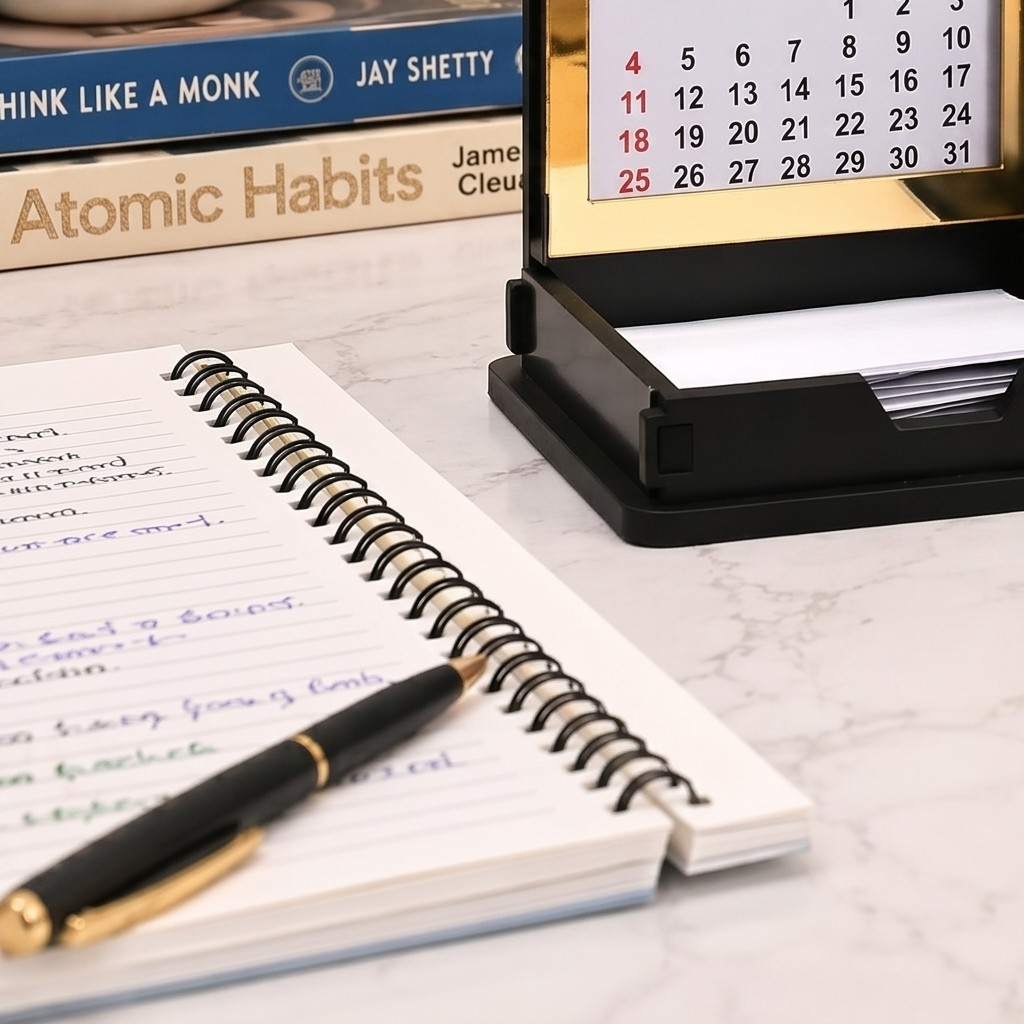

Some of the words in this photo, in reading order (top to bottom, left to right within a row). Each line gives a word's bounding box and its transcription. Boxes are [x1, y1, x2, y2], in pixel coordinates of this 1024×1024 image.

[626, 52, 641, 74] 4
[681, 47, 695, 70] 5
[736, 44, 750, 67] 6
[788, 39, 801, 62] 7
[843, 35, 856, 58] 8
[897, 31, 910, 54] 9
[943, 26, 970, 49] 10
[0, 88, 67, 120] HINK
[80, 82, 138, 113] LIKE
[149, 79, 167, 106] A
[179, 71, 260, 104] MONK
[357, 59, 397, 86] JAY
[408, 50, 493, 82] SHETTY
[621, 90, 645, 114] 11
[675, 86, 703, 110] 12
[729, 82, 757, 105] 13
[781, 77, 810, 101] 14
[836, 73, 864, 97] 15
[890, 69, 918, 92] 16
[943, 64, 970, 88] 17
[619, 129, 649, 153] 18
[675, 125, 703, 149] 19
[729, 120, 758, 145] 20
[782, 116, 807, 141] 21
[836, 112, 864, 136] 22
[889, 107, 918, 131] 23
[943, 102, 971, 127] 24
[619, 168, 650, 193] 25
[674, 164, 704, 189] 26
[729, 159, 758, 184] 27
[781, 154, 810, 180] 28
[836, 150, 864, 174] 29
[890, 146, 918, 169] 30
[944, 140, 968, 164] 31
[10, 173, 223, 245] Atomic
[244, 154, 422, 218] Habits
